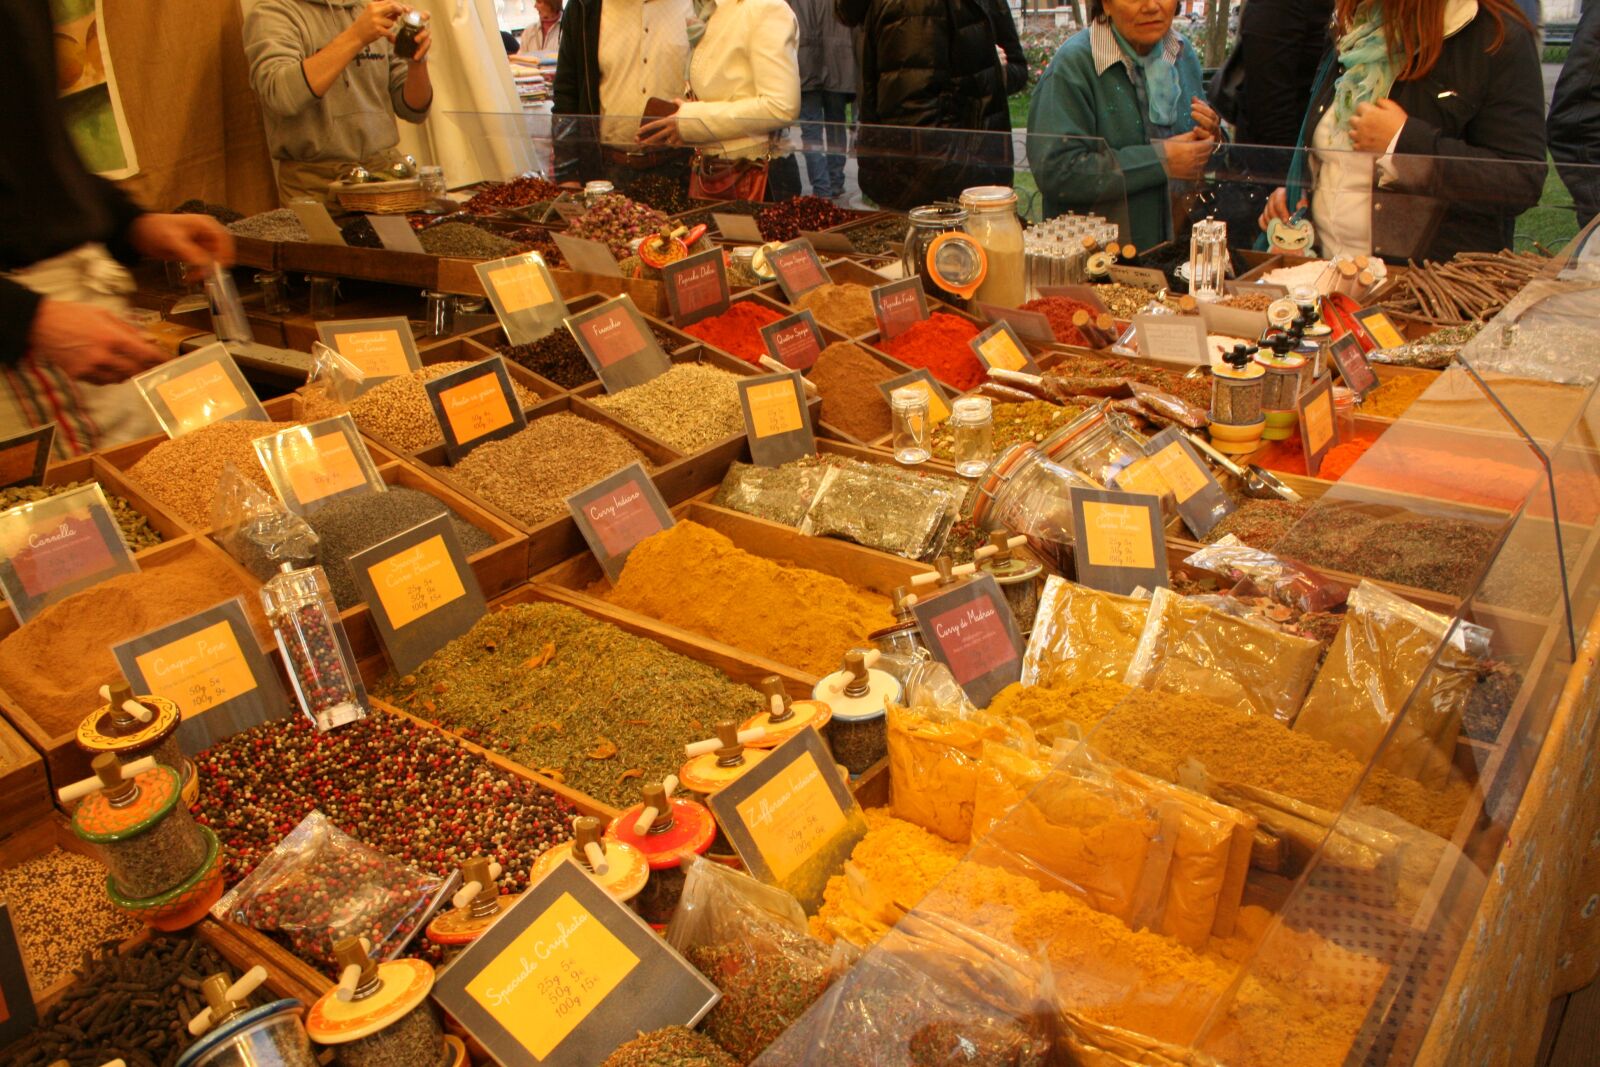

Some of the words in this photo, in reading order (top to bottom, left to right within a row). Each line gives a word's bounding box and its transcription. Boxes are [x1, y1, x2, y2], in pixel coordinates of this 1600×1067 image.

[590, 505, 616, 520] Curry
[28, 522, 77, 549] Cannella
[936, 623, 961, 639] Curry
[485, 957, 539, 1007] Speciale
[536, 975, 561, 996] 25g
[548, 984, 572, 1006] 50g
[554, 996, 582, 1019] 100g
